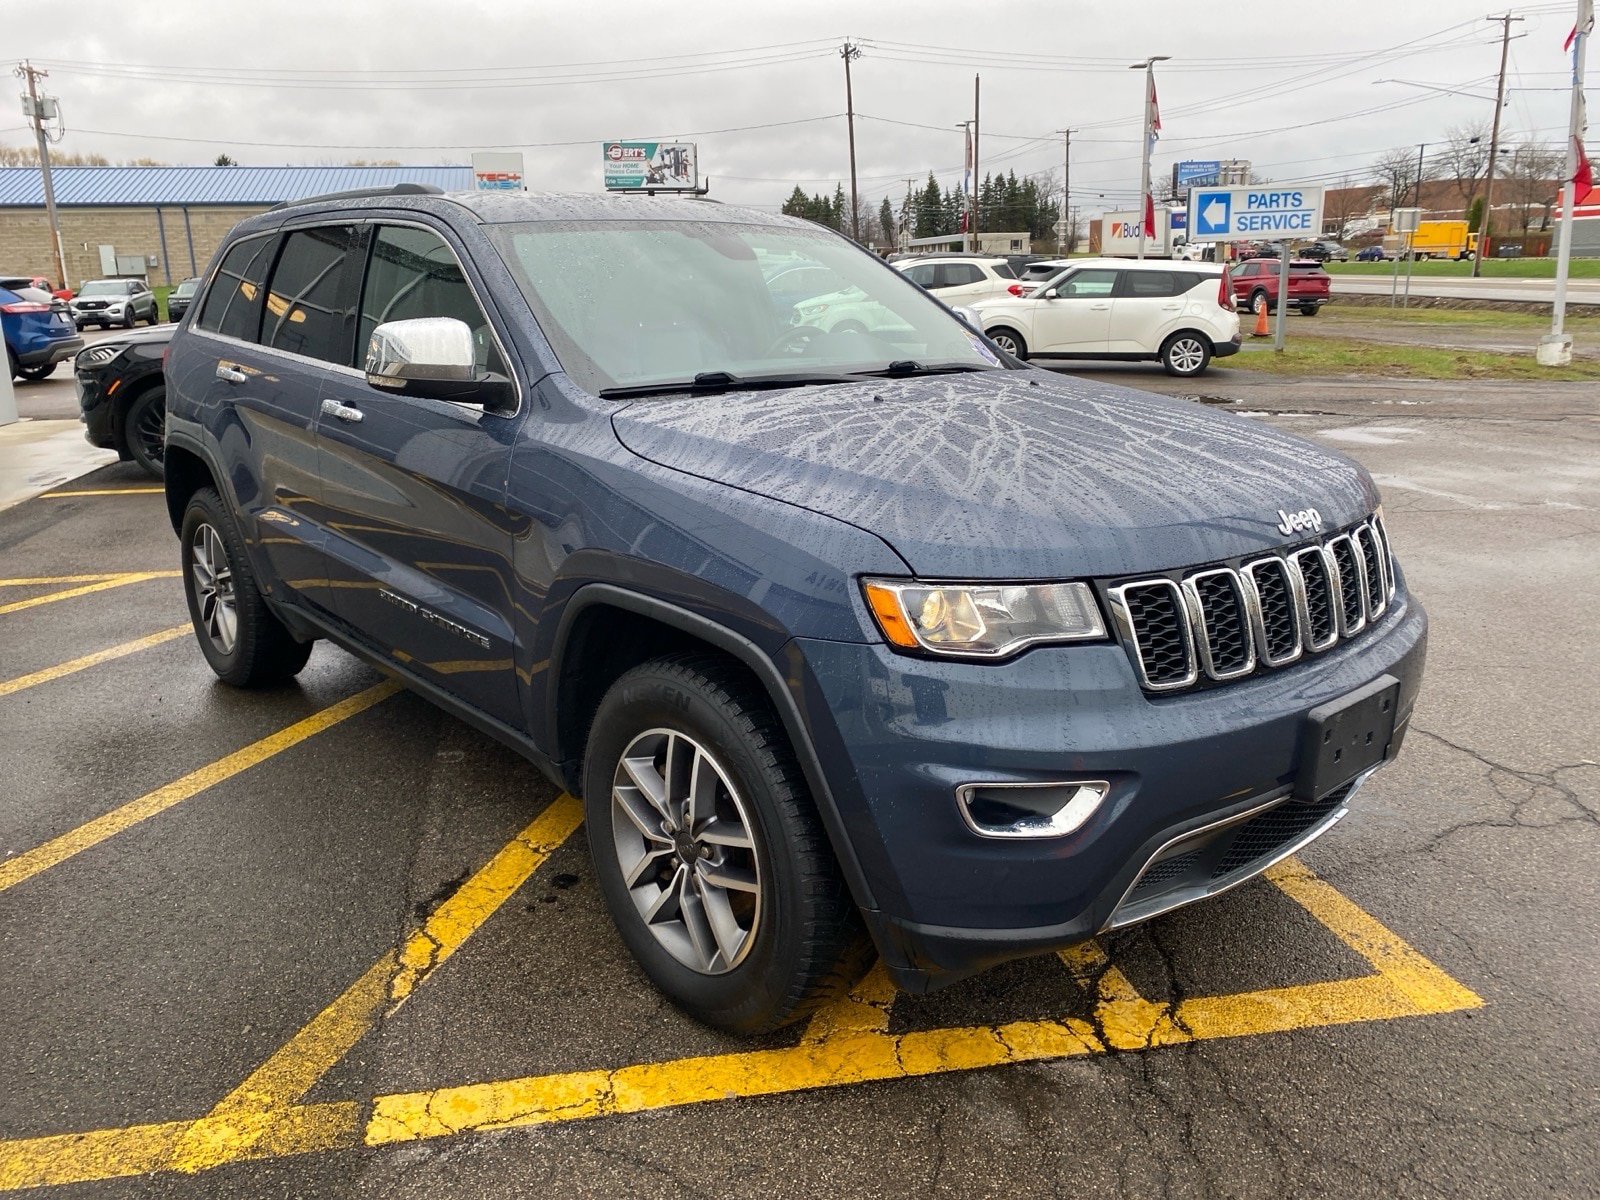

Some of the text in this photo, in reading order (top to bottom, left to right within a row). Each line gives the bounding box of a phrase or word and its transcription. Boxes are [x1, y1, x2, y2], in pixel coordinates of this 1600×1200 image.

[608, 146, 646, 160] BERT'S
[1247, 192, 1303, 209] PARTS
[1236, 213, 1312, 231] SERVICE
[1277, 508, 1322, 535] Jeep
